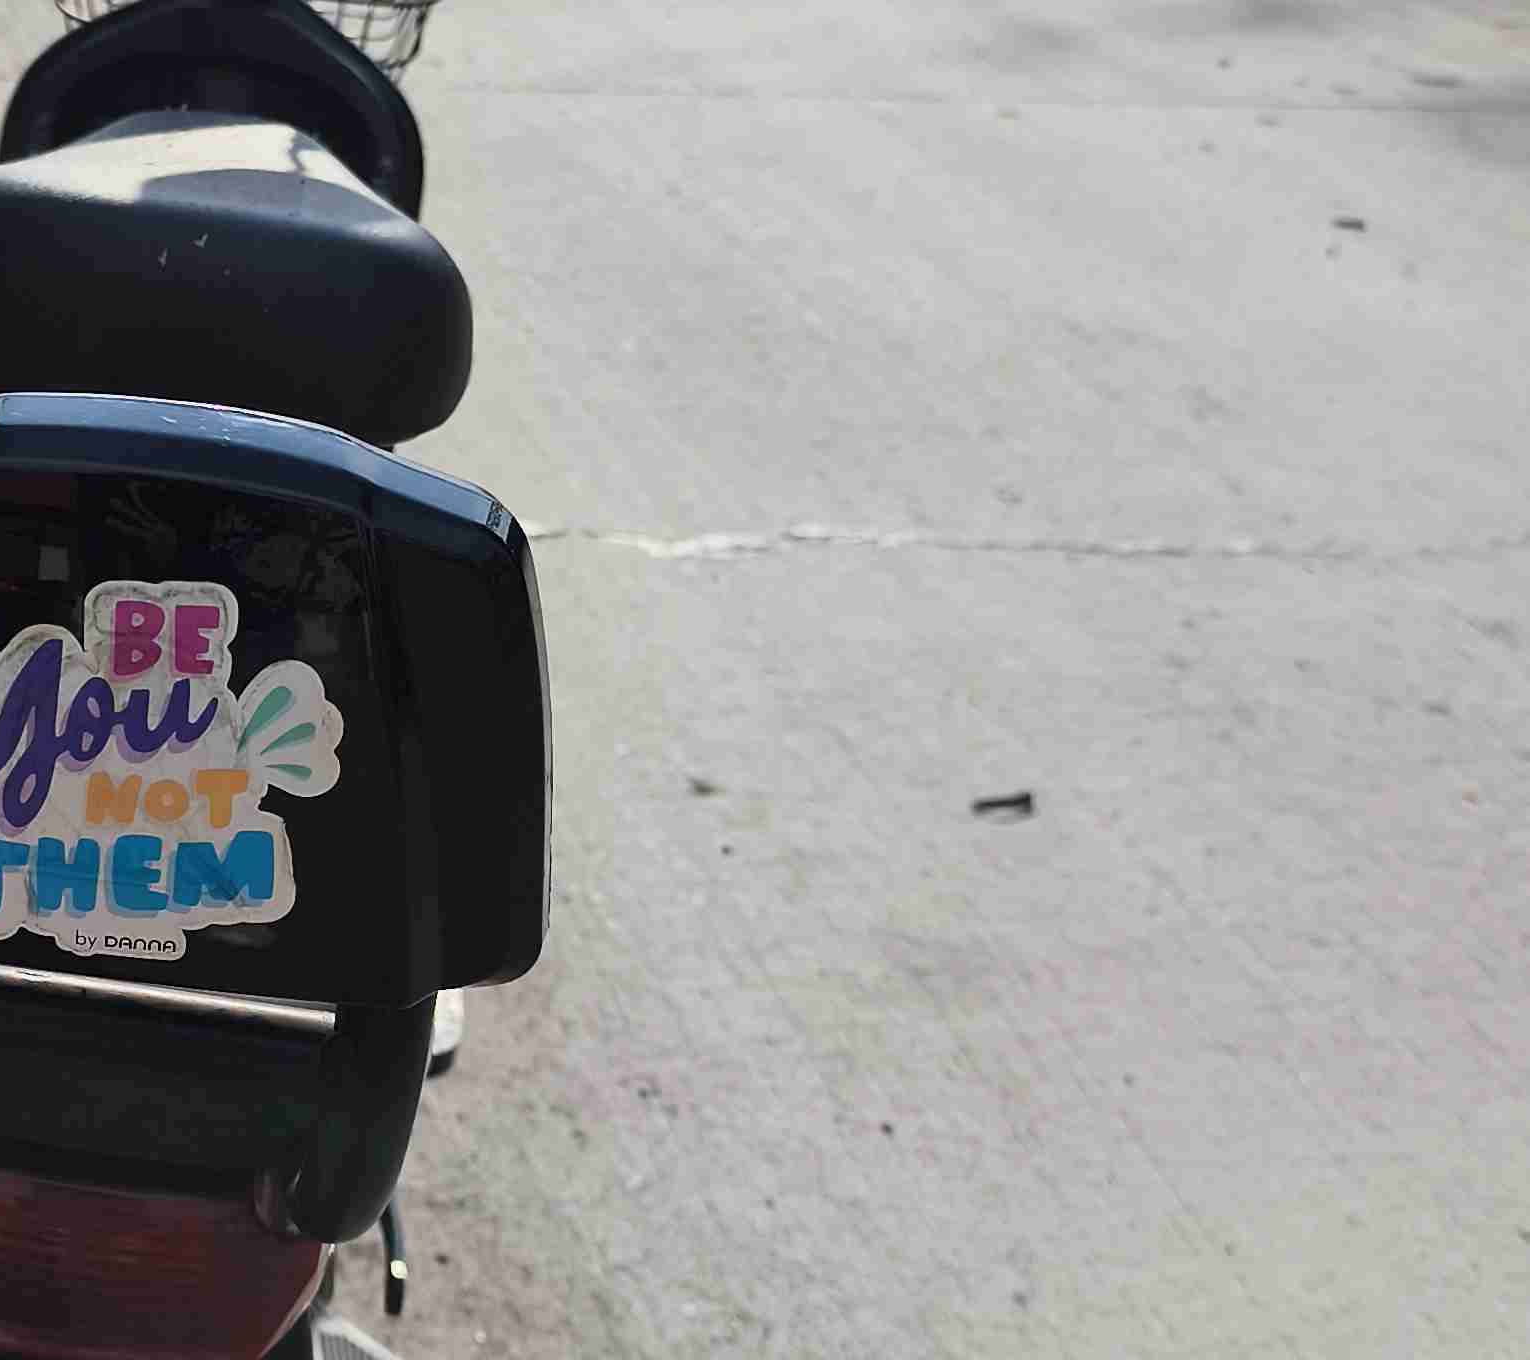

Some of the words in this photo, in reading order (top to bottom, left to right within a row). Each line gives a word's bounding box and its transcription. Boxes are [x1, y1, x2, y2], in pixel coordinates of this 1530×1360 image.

[110, 600, 221, 675] BE
[85, 769, 248, 828] NOT
[75, 929, 97, 949] by
